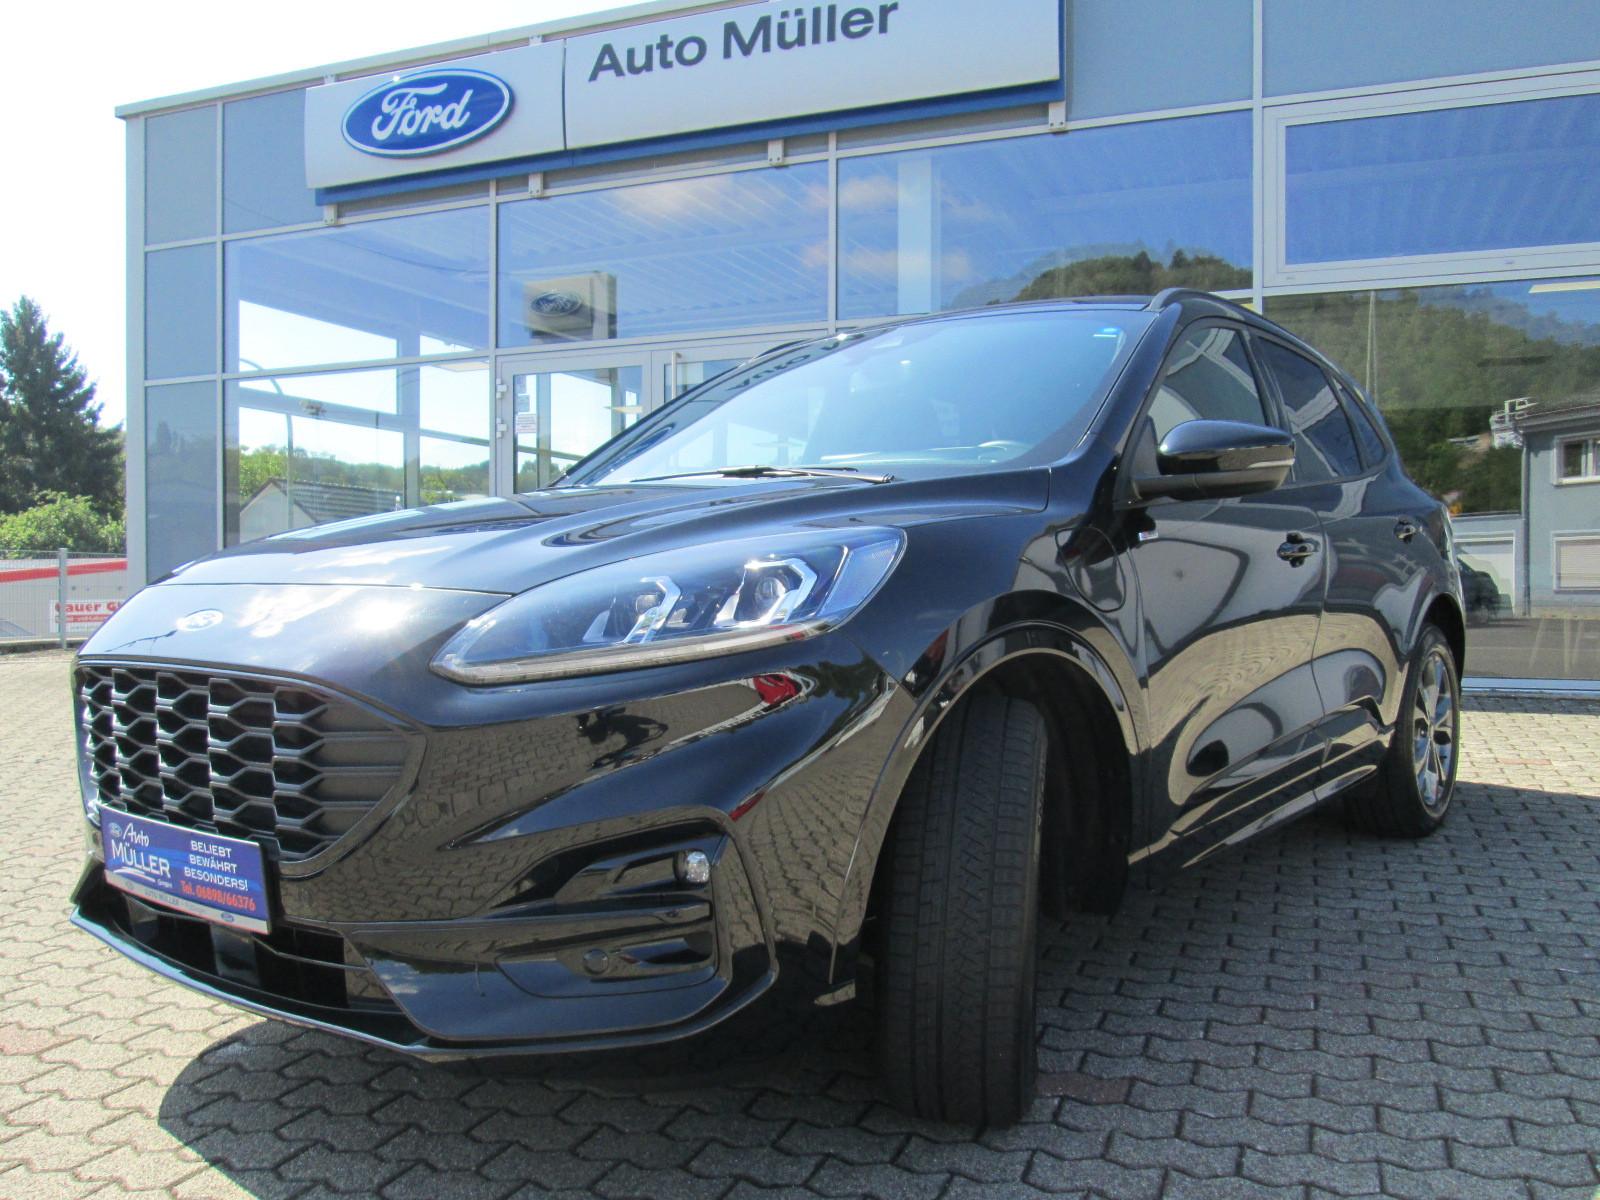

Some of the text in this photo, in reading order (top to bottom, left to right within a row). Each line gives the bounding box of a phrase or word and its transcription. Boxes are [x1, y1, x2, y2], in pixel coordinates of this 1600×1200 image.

[588, 2, 898, 82] Auto Müller
[372, 82, 473, 140] Ford
[122, 822, 150, 848] Auto
[111, 839, 171, 879] MÜLLER
[190, 840, 232, 858] BELIEBT
[189, 854, 238, 873] BEWÄHRT
[184, 867, 249, 891] BESONDERS!
